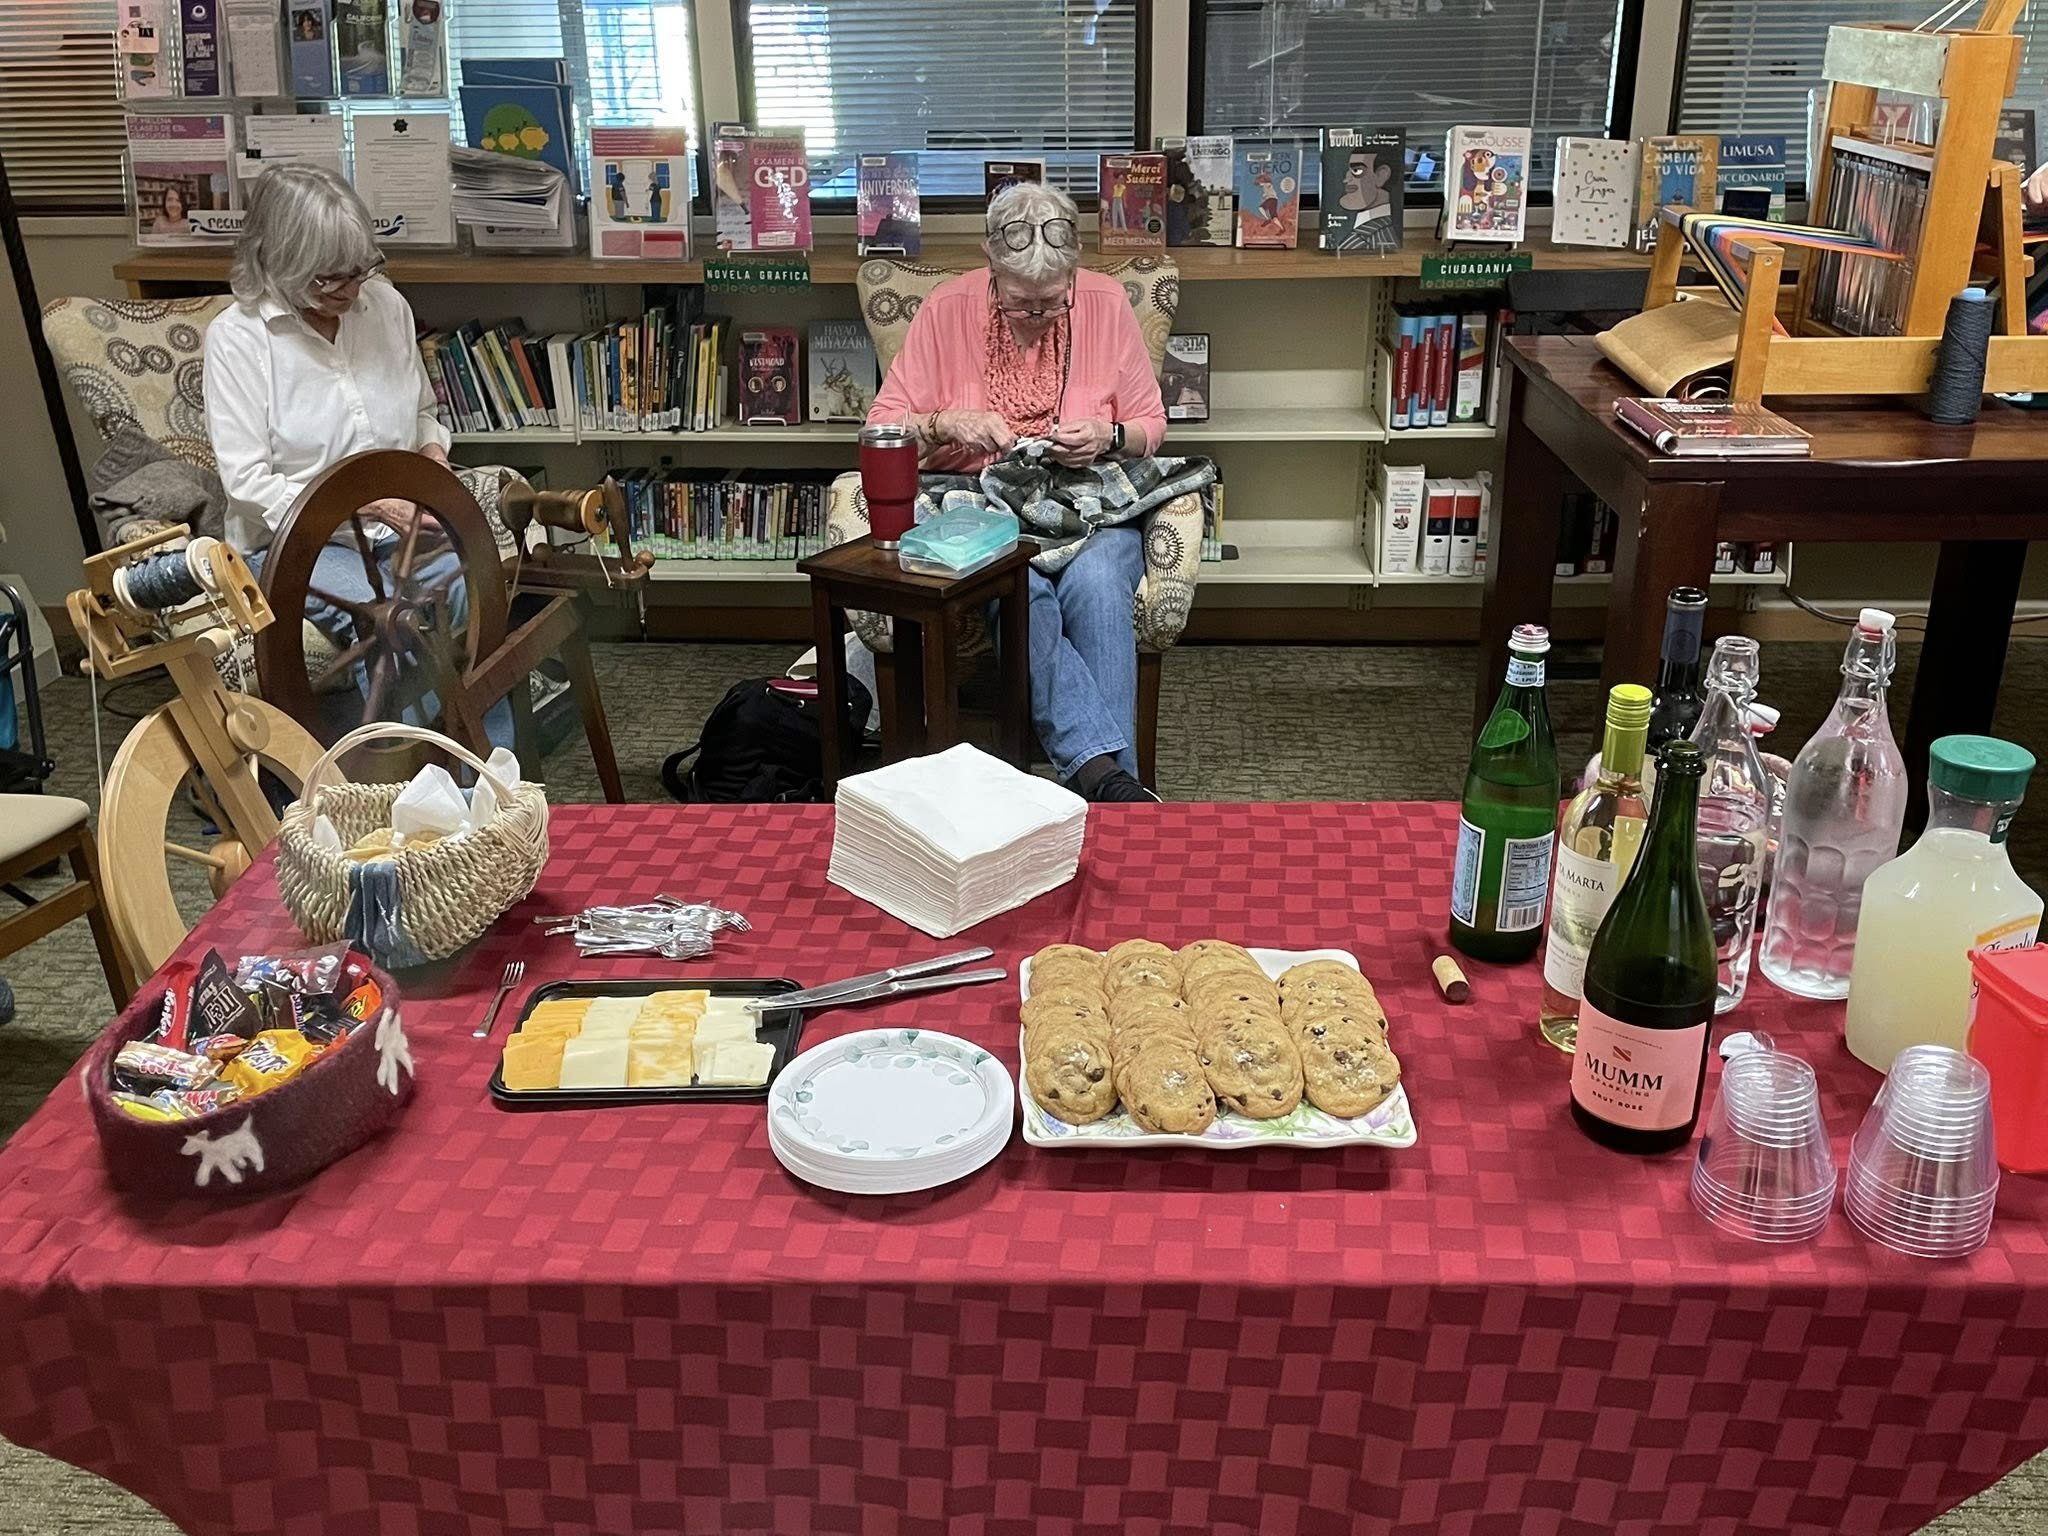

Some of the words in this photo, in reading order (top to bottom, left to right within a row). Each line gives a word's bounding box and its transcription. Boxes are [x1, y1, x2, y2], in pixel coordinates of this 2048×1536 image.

[1722, 144, 1776, 158] LIMUSA
[753, 158, 795, 166] EXAMEN
[1130, 163, 1162, 174] Merci
[753, 166, 808, 188] GED
[1653, 164, 1671, 176] TU
[1674, 164, 1706, 176] VIDA
[1125, 173, 1163, 184] Suárez
[1103, 236, 1126, 247] MEG
[1127, 236, 1163, 247] MEDINA
[706, 268, 751, 281] NOVELA
[759, 269, 810, 282] GRAFICA
[1440, 263, 1514, 275] CIUDADANIA
[823, 324, 857, 336] HAYAO
[814, 336, 868, 350] MIYAZAKI
[1566, 869, 1605, 892] MARTA
[1584, 1052, 1663, 1091] MUMM
[1590, 1074, 1650, 1098] SPARKLING
[1592, 1090, 1614, 1104] BRUT
